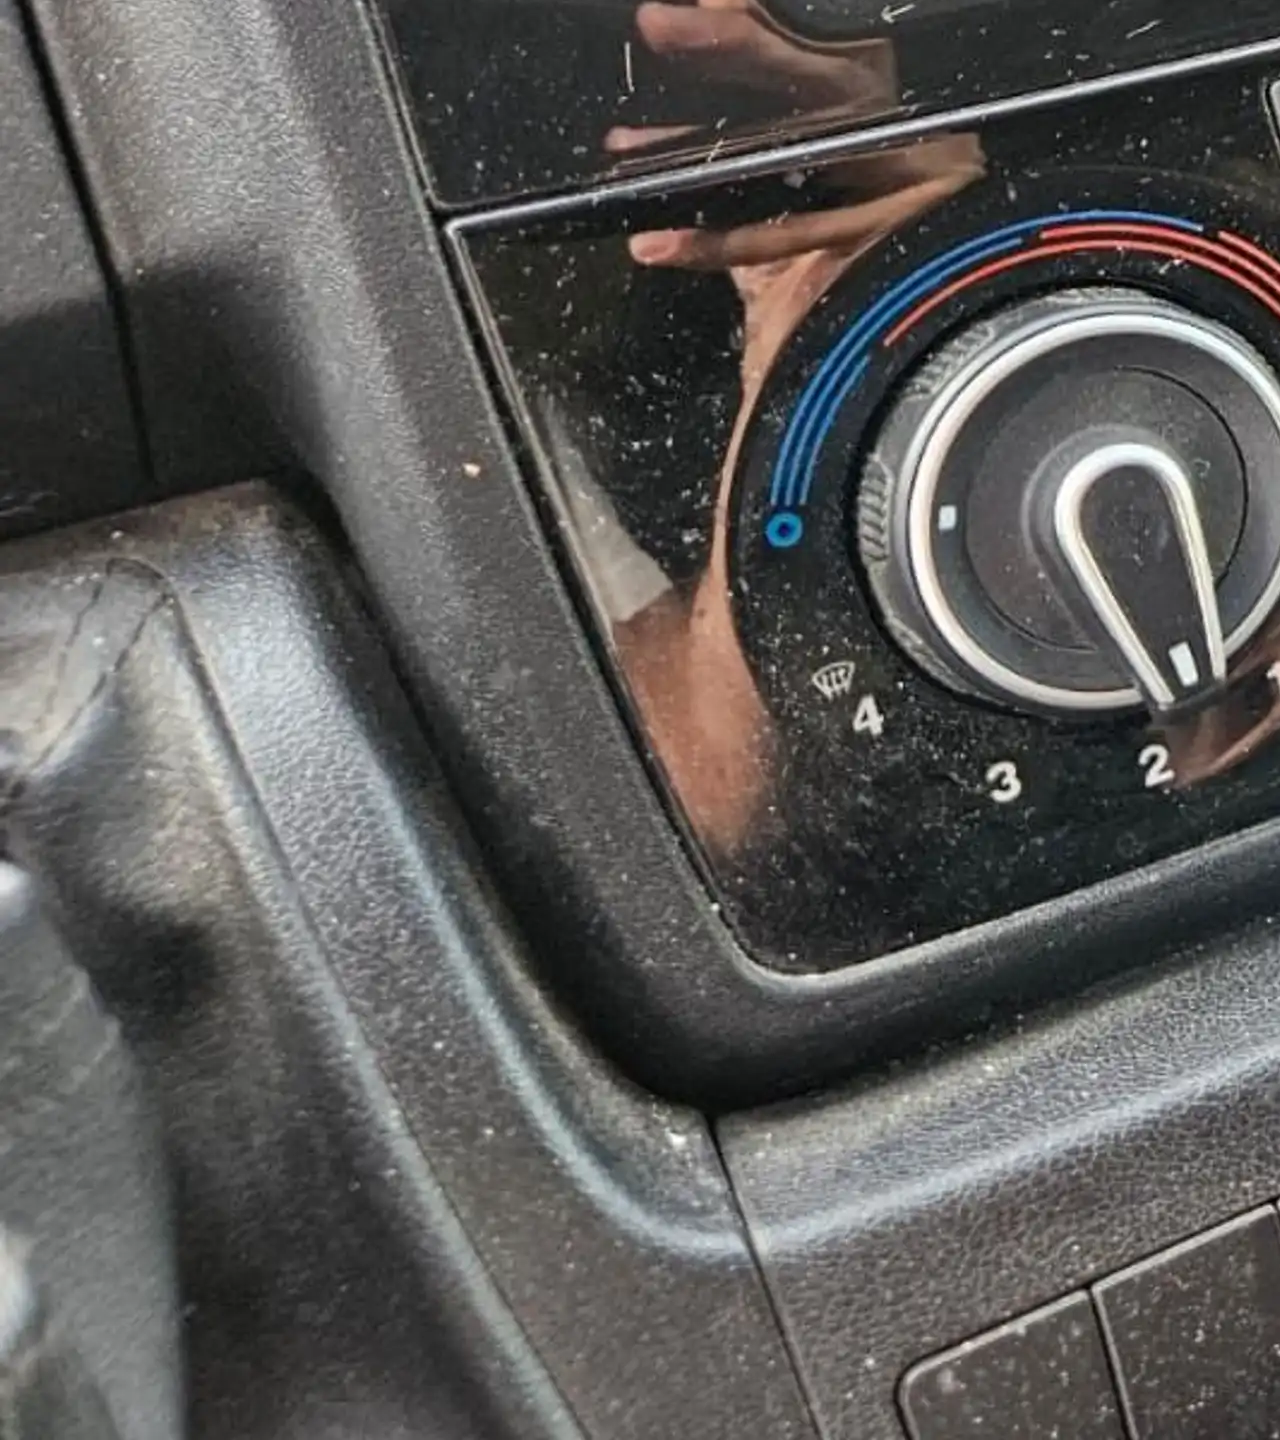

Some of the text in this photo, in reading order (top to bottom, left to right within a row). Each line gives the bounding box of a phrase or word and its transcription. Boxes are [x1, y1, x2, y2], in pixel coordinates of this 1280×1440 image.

[851, 694, 885, 737] 4
[985, 761, 1022, 804] 3
[1138, 744, 1175, 788] 2
